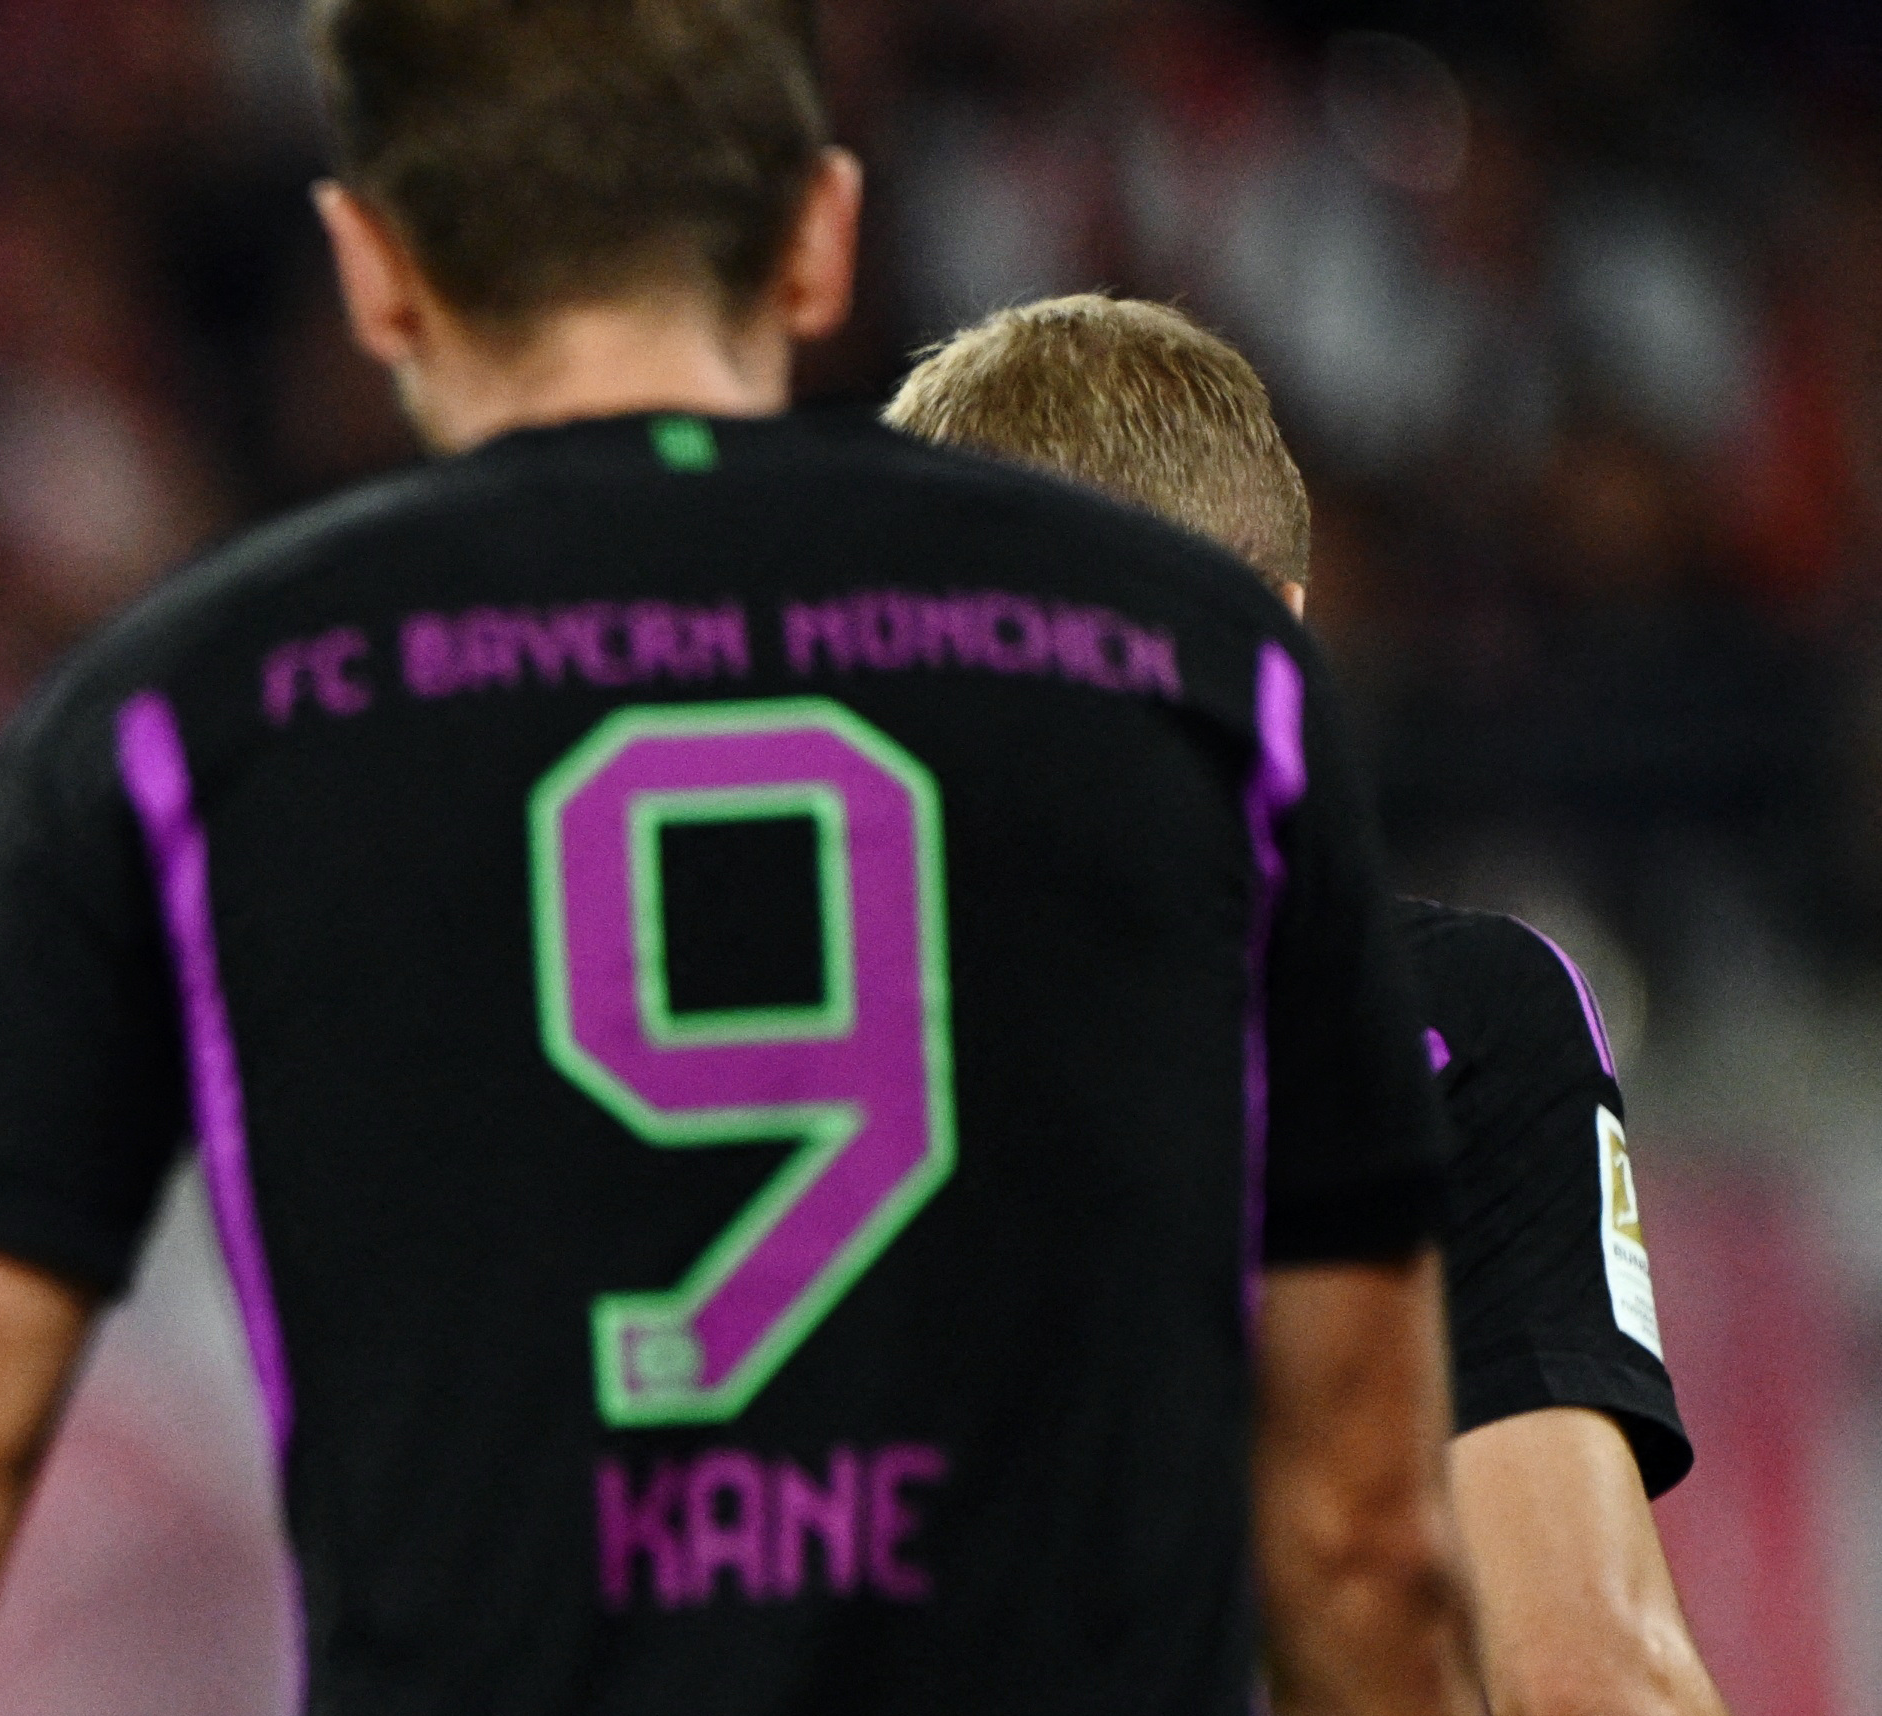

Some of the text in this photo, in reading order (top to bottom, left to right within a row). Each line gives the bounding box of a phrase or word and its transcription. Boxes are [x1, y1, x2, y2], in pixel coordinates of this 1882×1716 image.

[261, 590, 1183, 724] FC BAYERN MÜNCHEN
[526, 696, 954, 1425] 9
[595, 1442, 949, 1611] KANE
